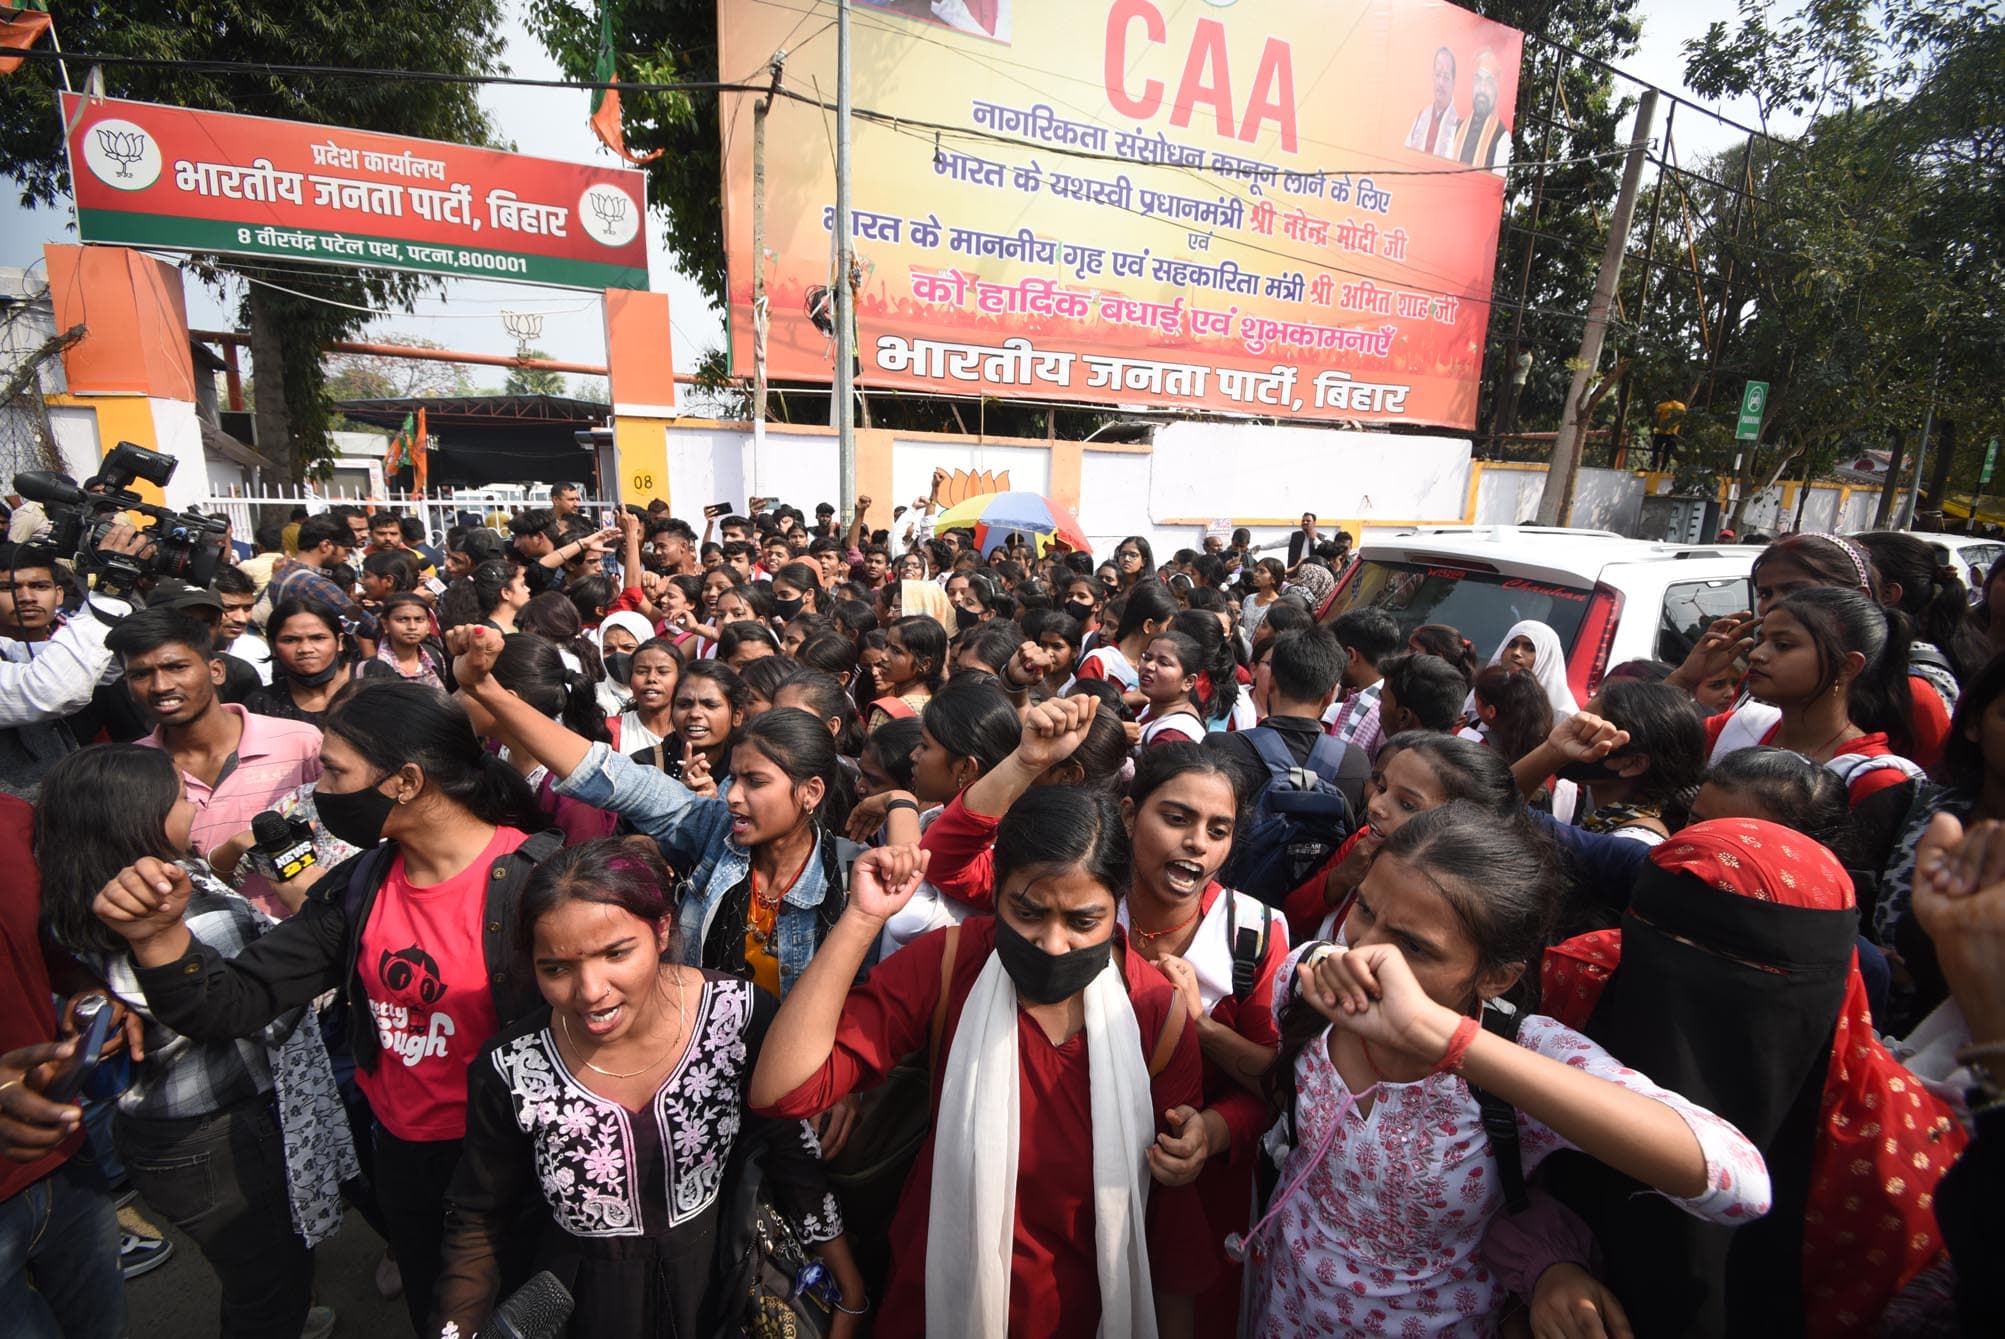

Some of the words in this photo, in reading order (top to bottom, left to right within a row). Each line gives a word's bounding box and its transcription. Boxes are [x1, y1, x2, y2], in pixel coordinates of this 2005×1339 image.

[1103, 0, 1298, 155] CAA
[310, 140, 359, 170] प्रदेश
[362, 150, 446, 181] कार्यालय
[972, 101, 1108, 152] नागरिकता
[1211, 151, 1279, 197] कानून
[1284, 170, 1326, 198] लाने
[1331, 175, 1351, 203] के
[1355, 178, 1391, 213] लिए
[174, 158, 304, 206] भारतीय
[308, 175, 404, 217] जनता
[407, 182, 482, 232] पार्टी,
[486, 188, 568, 237] बिहार
[933, 151, 1006, 188] भारत
[1012, 160, 1043, 193] के
[1050, 172, 1132, 210] यशस्वी
[1139, 189, 1244, 230] प्रधानमंत्री
[1249, 200, 1277, 236] श्री
[1284, 209, 1330, 247] नरेन्द्र
[1336, 218, 1377, 255] मोदी
[1383, 229, 1408, 261] जी
[237, 228, 251, 244] 8
[255, 227, 317, 251] वीरचंद्र
[319, 233, 364, 255] पटेल
[366, 241, 403, 261] पथ,
[910, 214, 941, 248] के
[949, 228, 1058, 265] माननीय
[1063, 244, 1105, 280] गृह
[1112, 247, 1150, 278] एवं
[1152, 257, 1260, 295] सहकारिता
[1265, 272, 1305, 302] मंत्री
[1310, 275, 1334, 306] श्री
[1341, 281, 1392, 314] अमित
[1397, 295, 1432, 320] शाह
[1433, 292, 1459, 325] जी
[1188, 231, 1213, 251] एवं
[912, 269, 968, 307] को
[976, 277, 1092, 319] हार्दिक
[1100, 295, 1185, 334] बधाई
[1190, 306, 1239, 337] एवं
[1239, 317, 1397, 356] शुभकामनाएँ
[876, 335, 1076, 387] भारतीय
[1081, 354, 1211, 399] जनता
[1216, 365, 1304, 413] पार्टी,
[1313, 370, 1411, 414] बिहार
[633, 475, 653, 490] 08
[275, 841, 312, 869] NEWS
[379, 1012, 455, 1067] ough
